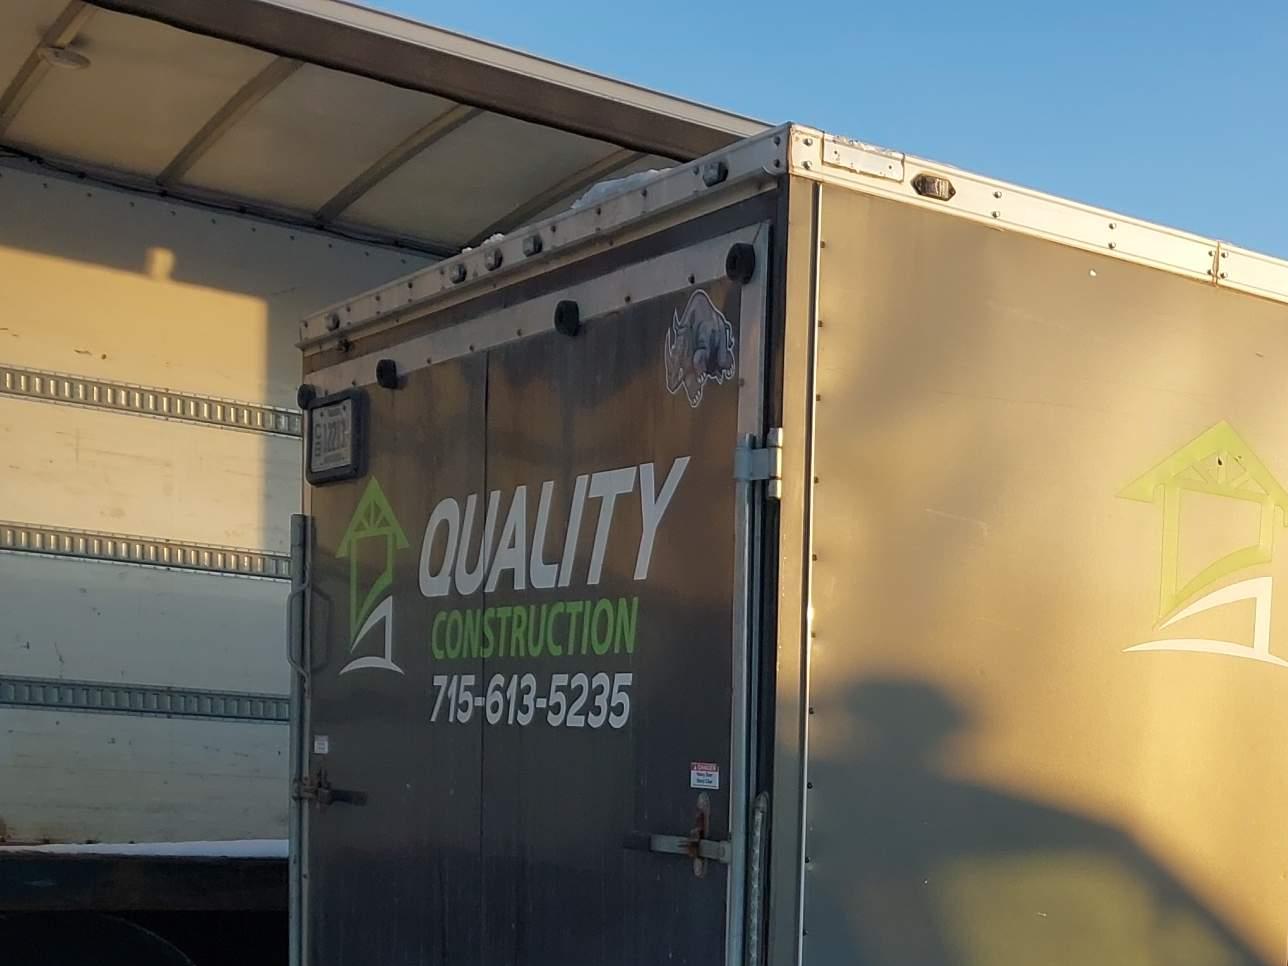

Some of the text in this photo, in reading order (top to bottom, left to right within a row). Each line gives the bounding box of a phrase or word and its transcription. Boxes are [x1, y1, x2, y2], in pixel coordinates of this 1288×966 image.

[418, 456, 692, 598] QUALITY
[431, 597, 639, 660] CONSTRUCTION
[430, 672, 634, 728] 715-613-5235
